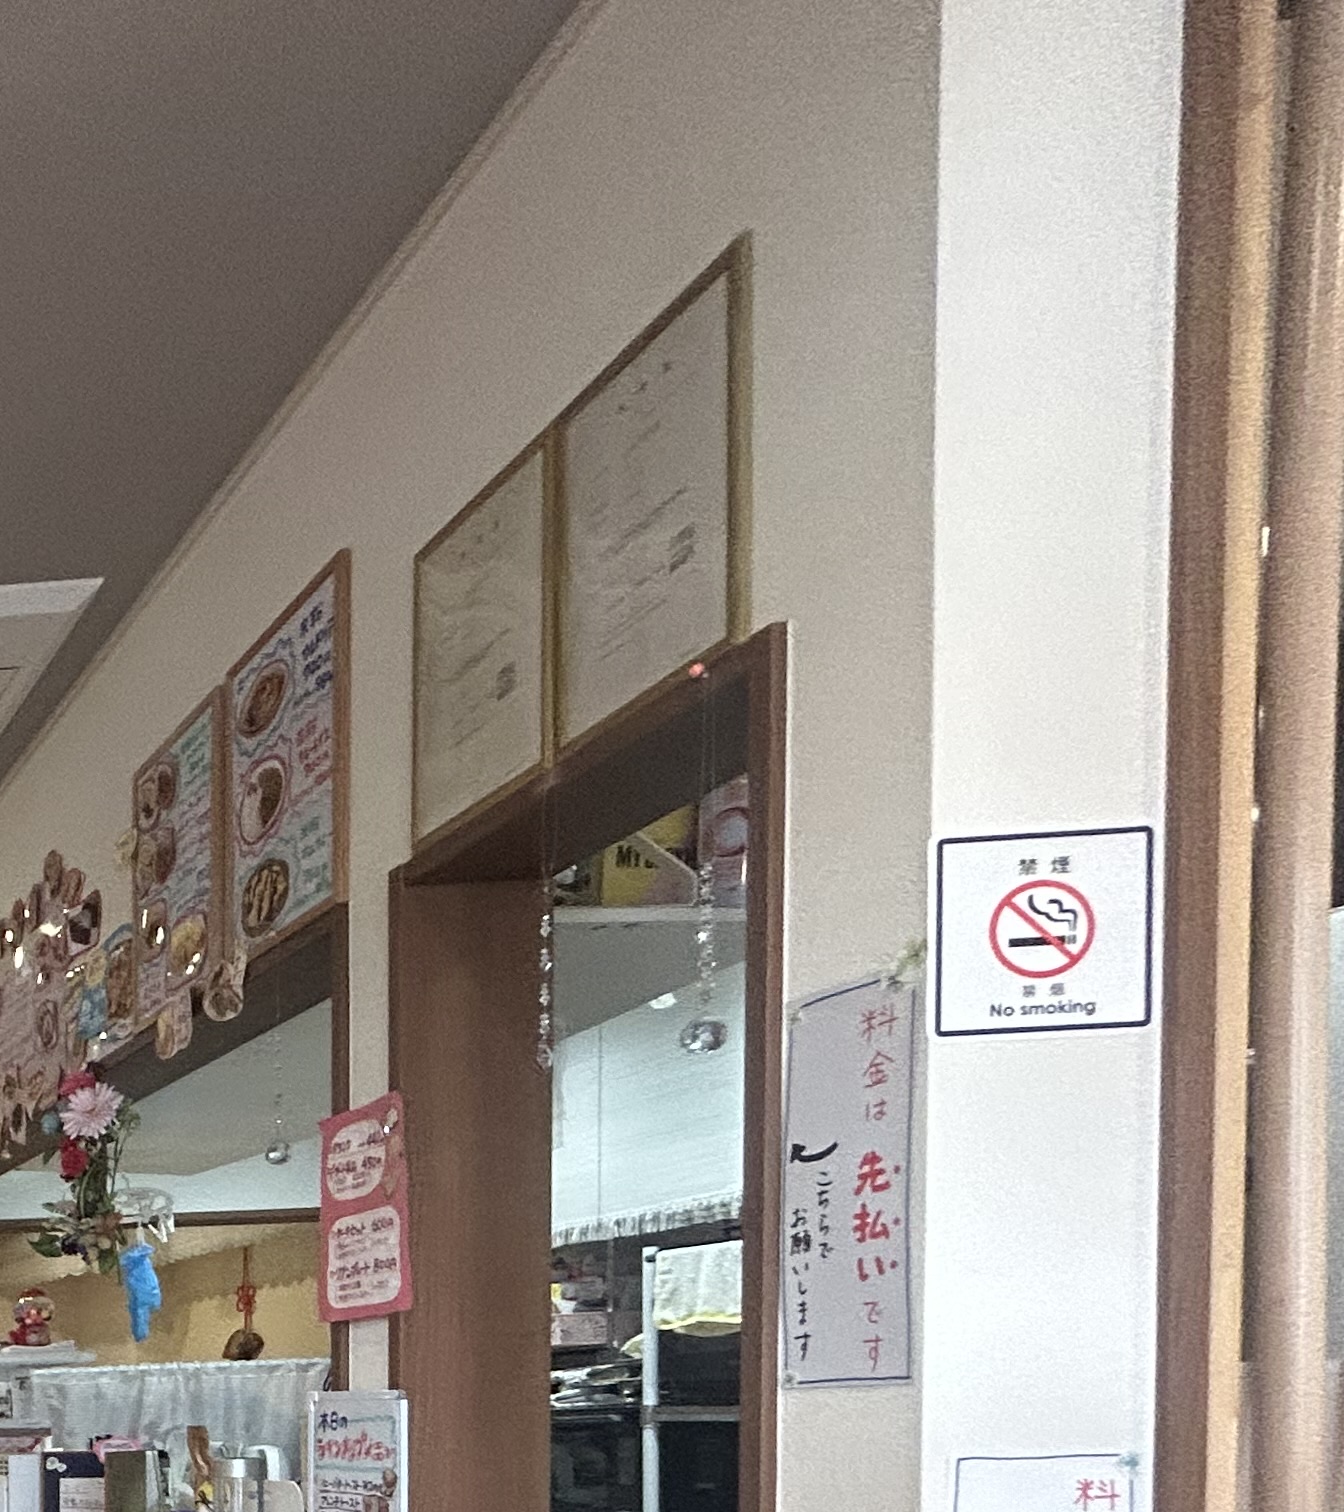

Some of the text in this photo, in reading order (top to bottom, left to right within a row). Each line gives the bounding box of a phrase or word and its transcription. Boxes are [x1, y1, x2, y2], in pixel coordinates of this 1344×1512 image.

[1018, 855, 1073, 876] 禁煙
[989, 999, 1098, 1018] No smoking
[816, 1171, 834, 1259] こちらで
[790, 1208, 812, 1361] お願いします
[318, 1410, 348, 1432] 本日の
